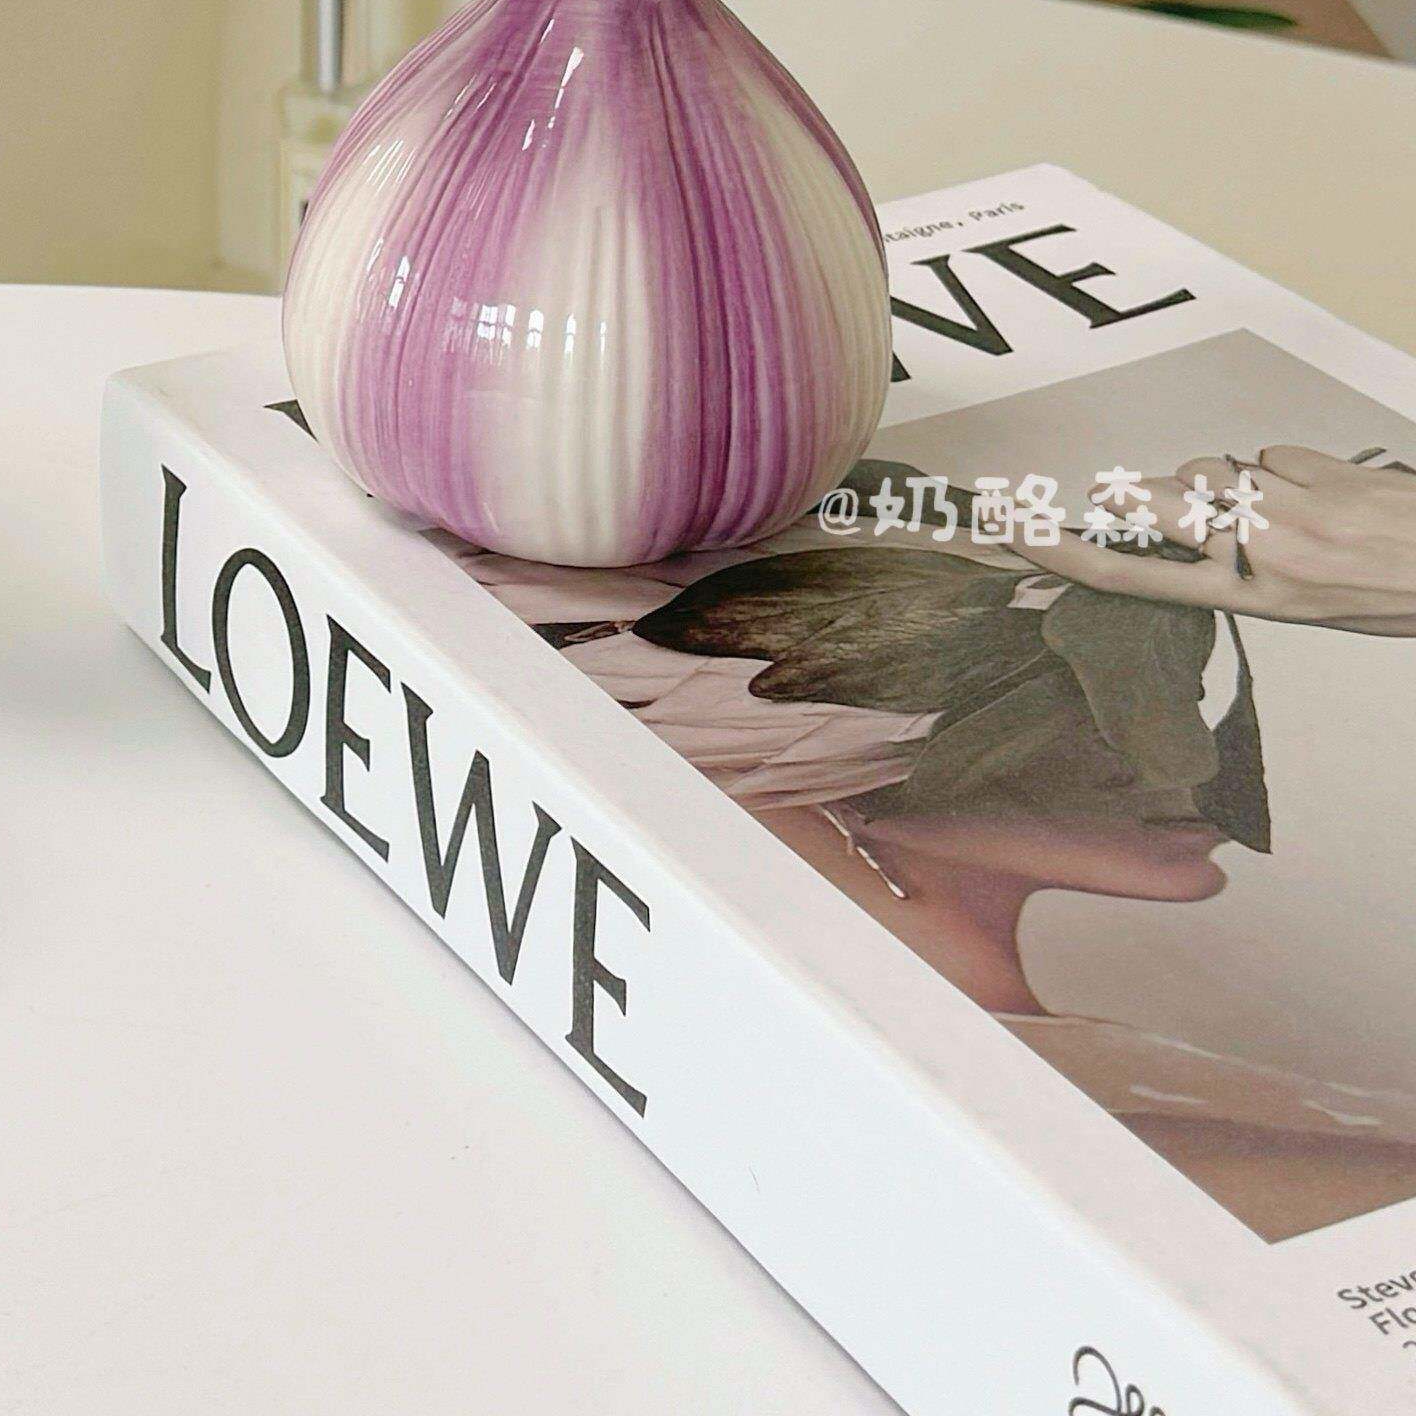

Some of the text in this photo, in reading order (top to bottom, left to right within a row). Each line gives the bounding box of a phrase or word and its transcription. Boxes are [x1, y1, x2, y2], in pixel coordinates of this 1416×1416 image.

[885, 201, 1025, 243] taigne, Paris
[160, 463, 651, 1118] LOEWE
